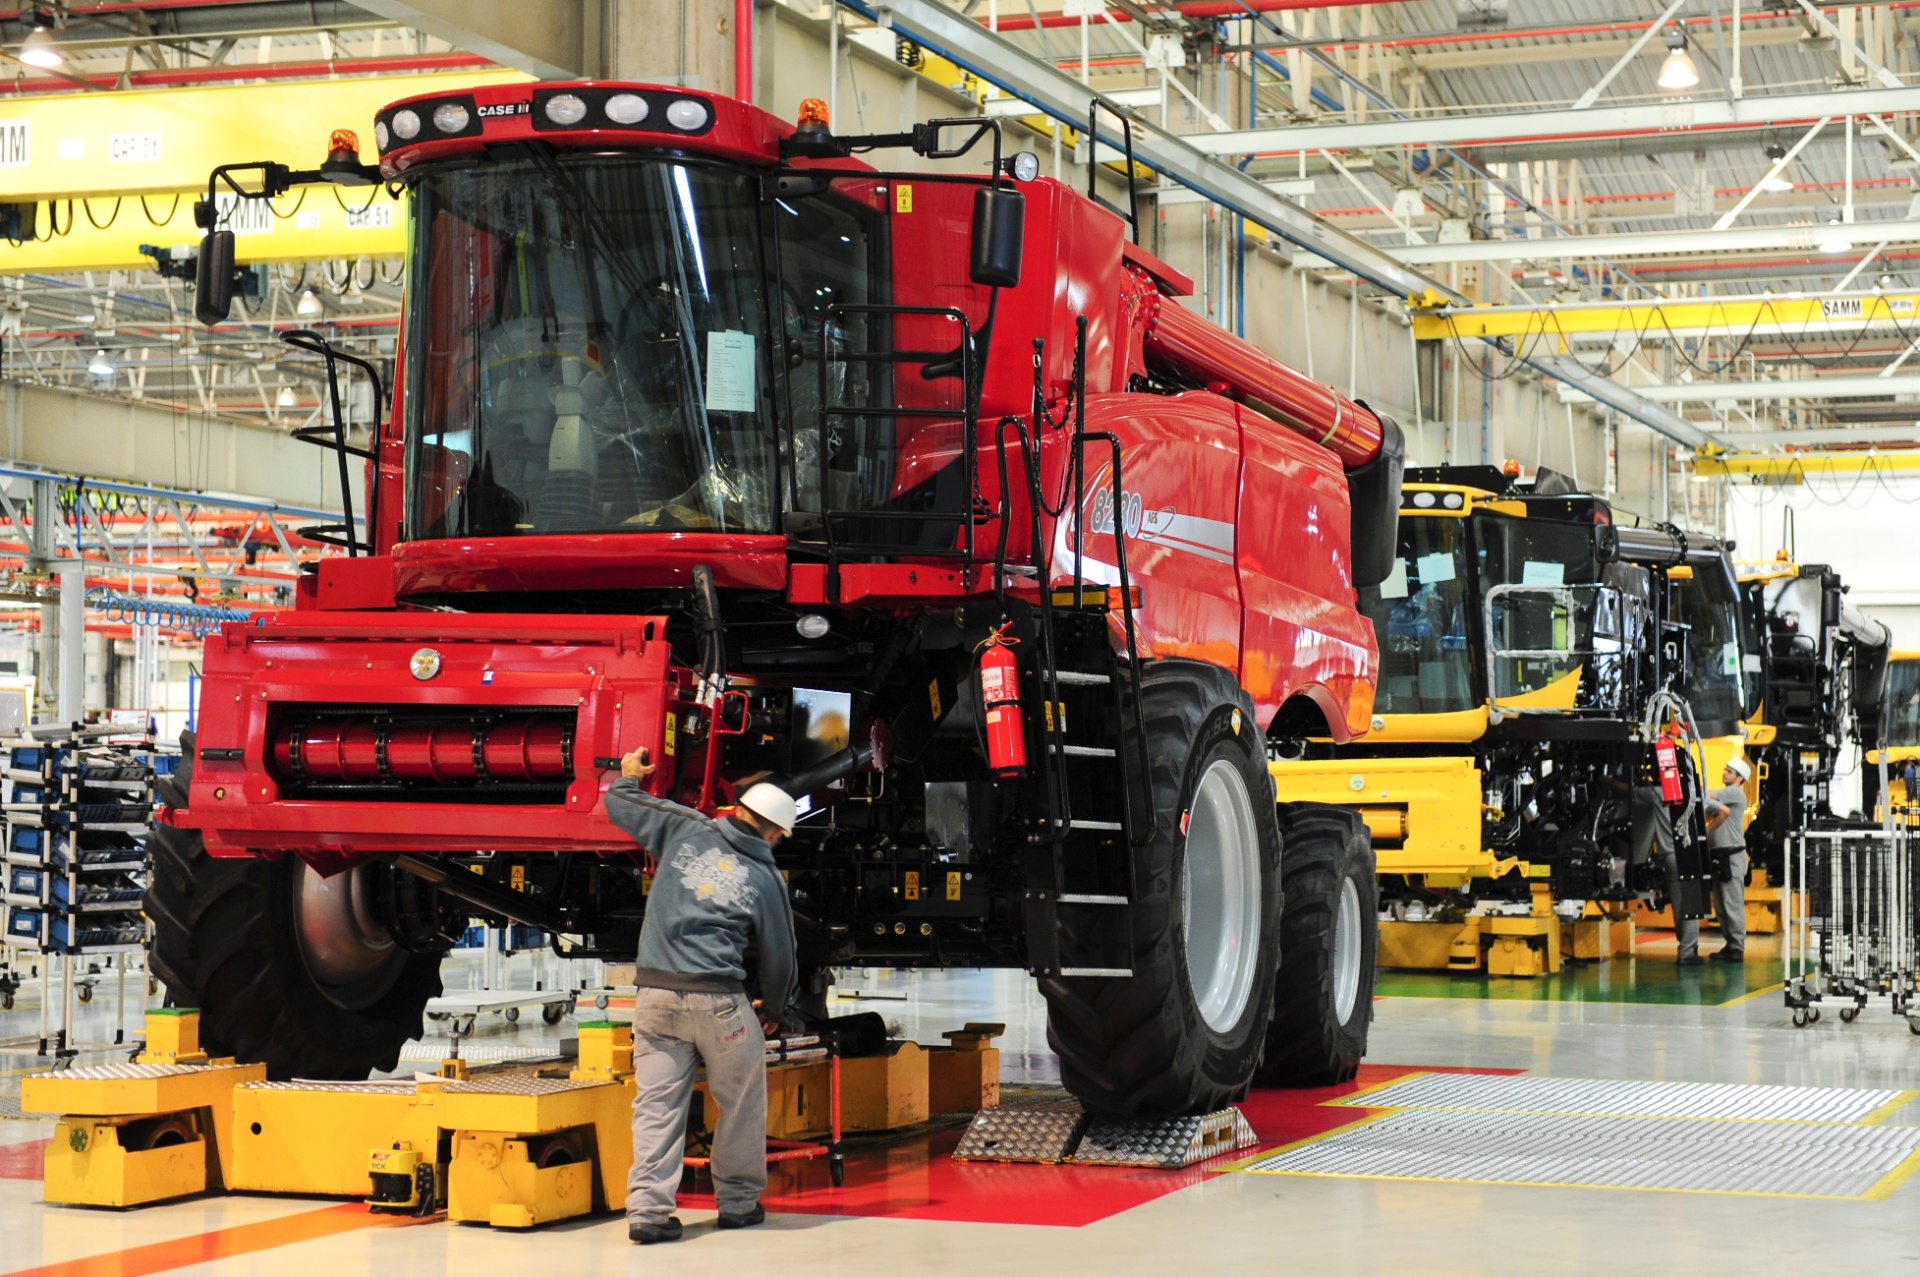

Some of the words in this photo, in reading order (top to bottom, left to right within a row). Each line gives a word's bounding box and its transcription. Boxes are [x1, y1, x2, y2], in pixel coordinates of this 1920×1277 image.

[477, 105, 514, 116] CASE
[218, 195, 269, 230] AMM
[349, 209, 370, 226] CAP
[376, 208, 382, 225] 5
[1824, 300, 1861, 316] SAMM
